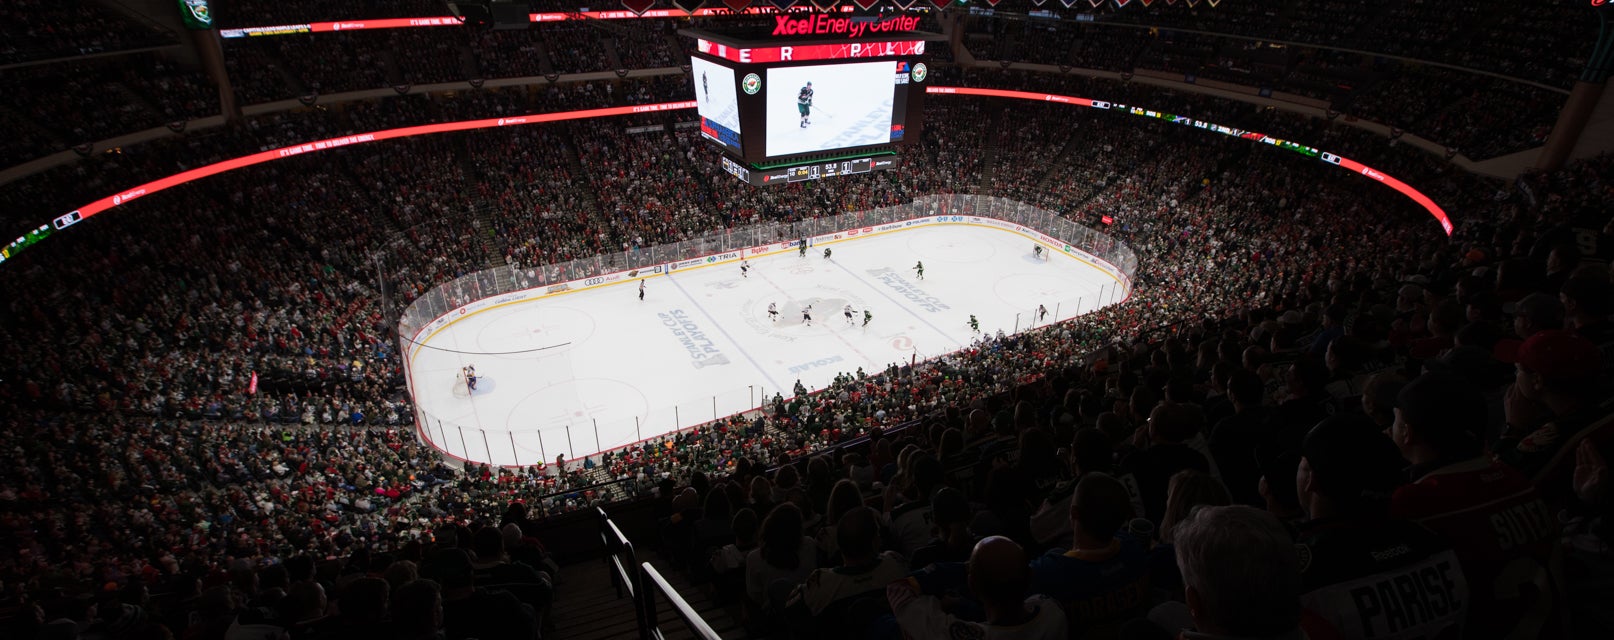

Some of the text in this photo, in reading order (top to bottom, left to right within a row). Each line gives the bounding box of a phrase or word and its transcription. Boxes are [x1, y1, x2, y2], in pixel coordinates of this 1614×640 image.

[772, 15, 920, 38] Xcel Energy Center
[1039, 235, 1064, 249] HONDA
[718, 252, 738, 261] TRIA
[876, 276, 942, 313] PLAYOFFS
[669, 309, 721, 354] PLAYOFFS
[670, 327, 707, 360] STANLEY
[787, 355, 845, 375] ECOLAB
[1350, 561, 1462, 638] PARISE
